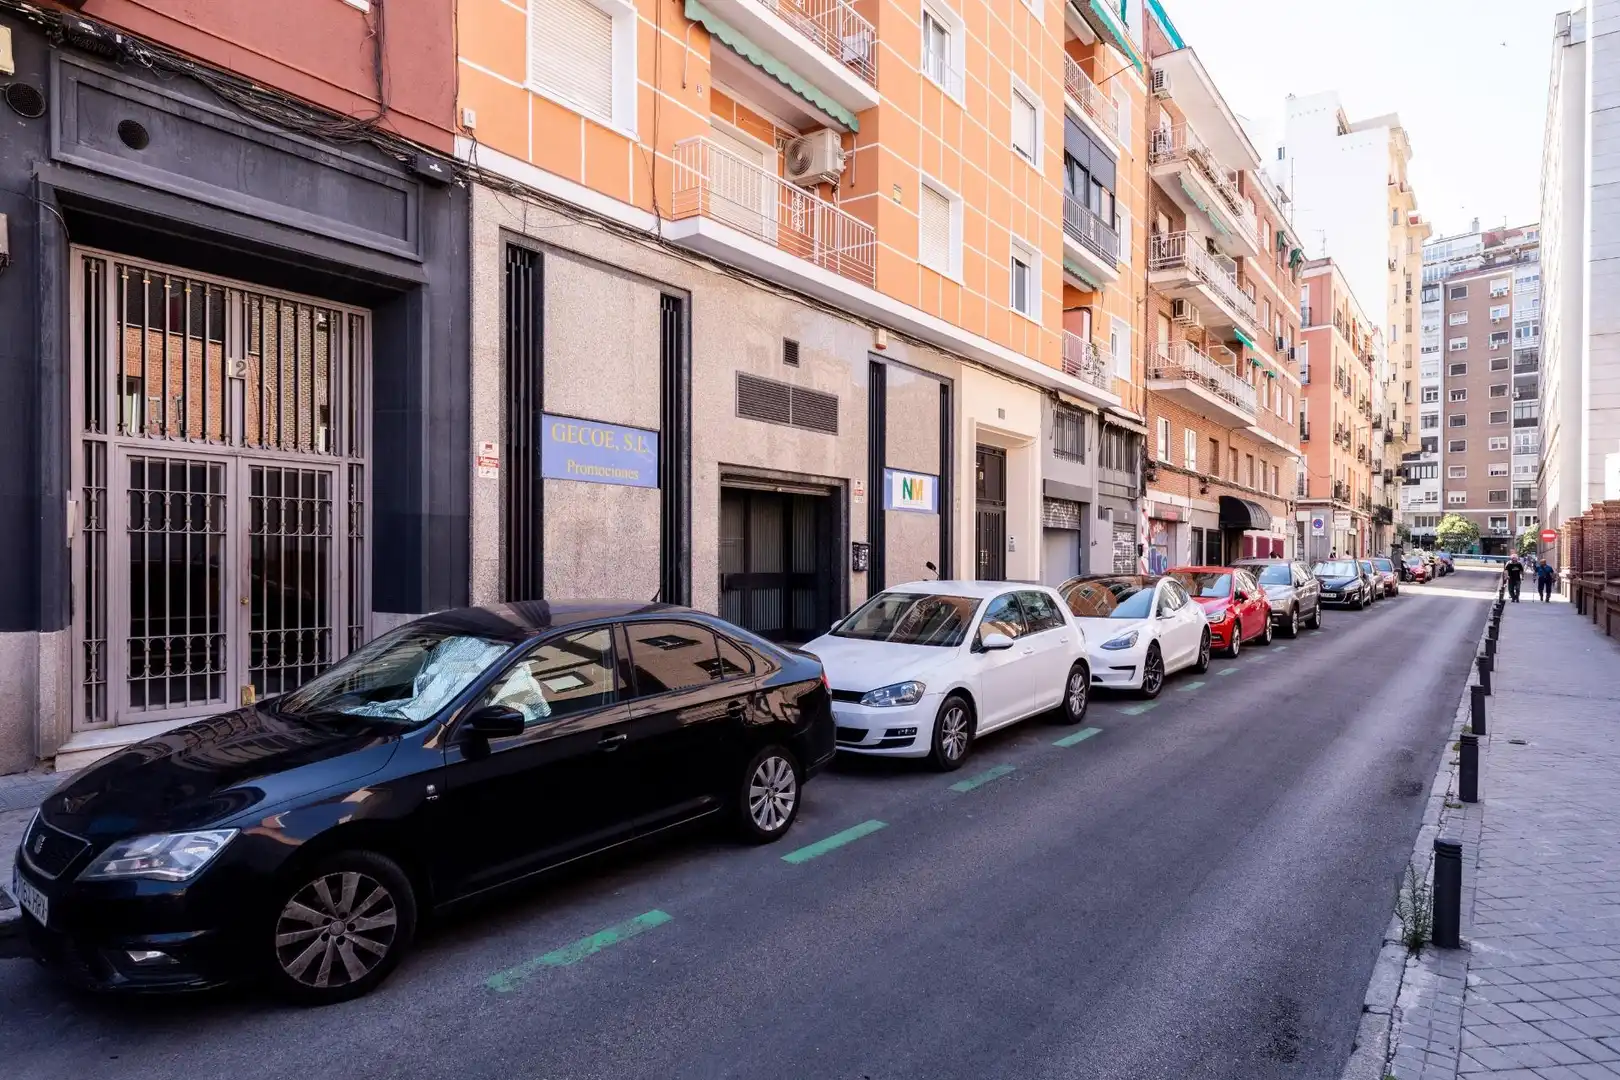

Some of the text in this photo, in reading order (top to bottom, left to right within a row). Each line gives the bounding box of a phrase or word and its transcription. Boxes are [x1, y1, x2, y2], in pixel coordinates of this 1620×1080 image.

[227, 358, 247, 378] 12
[551, 422, 619, 450] GECOE,
[567, 459, 639, 480] Promociones
[902, 476, 924, 501] NM
